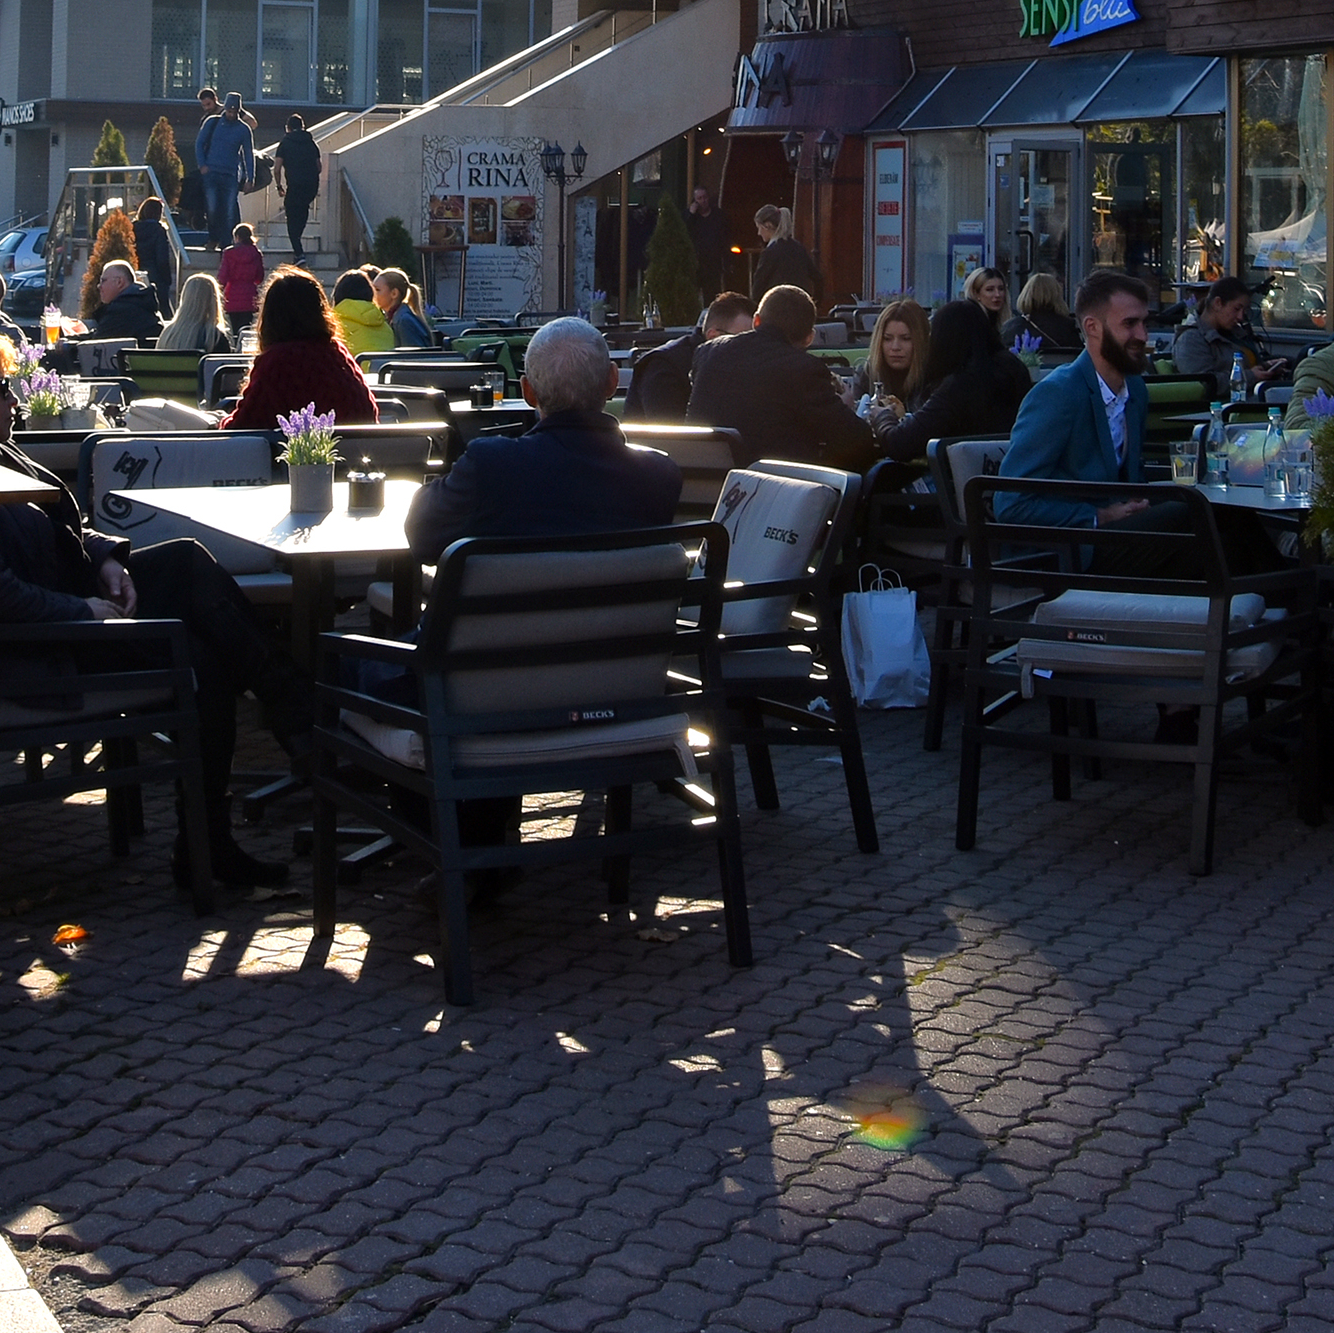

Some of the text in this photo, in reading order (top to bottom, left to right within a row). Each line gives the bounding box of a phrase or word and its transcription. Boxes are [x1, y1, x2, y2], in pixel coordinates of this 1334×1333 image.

[467, 152, 526, 166] CRAMA
[468, 168, 529, 187] RINA
[763, 526, 799, 545] BECK'S
